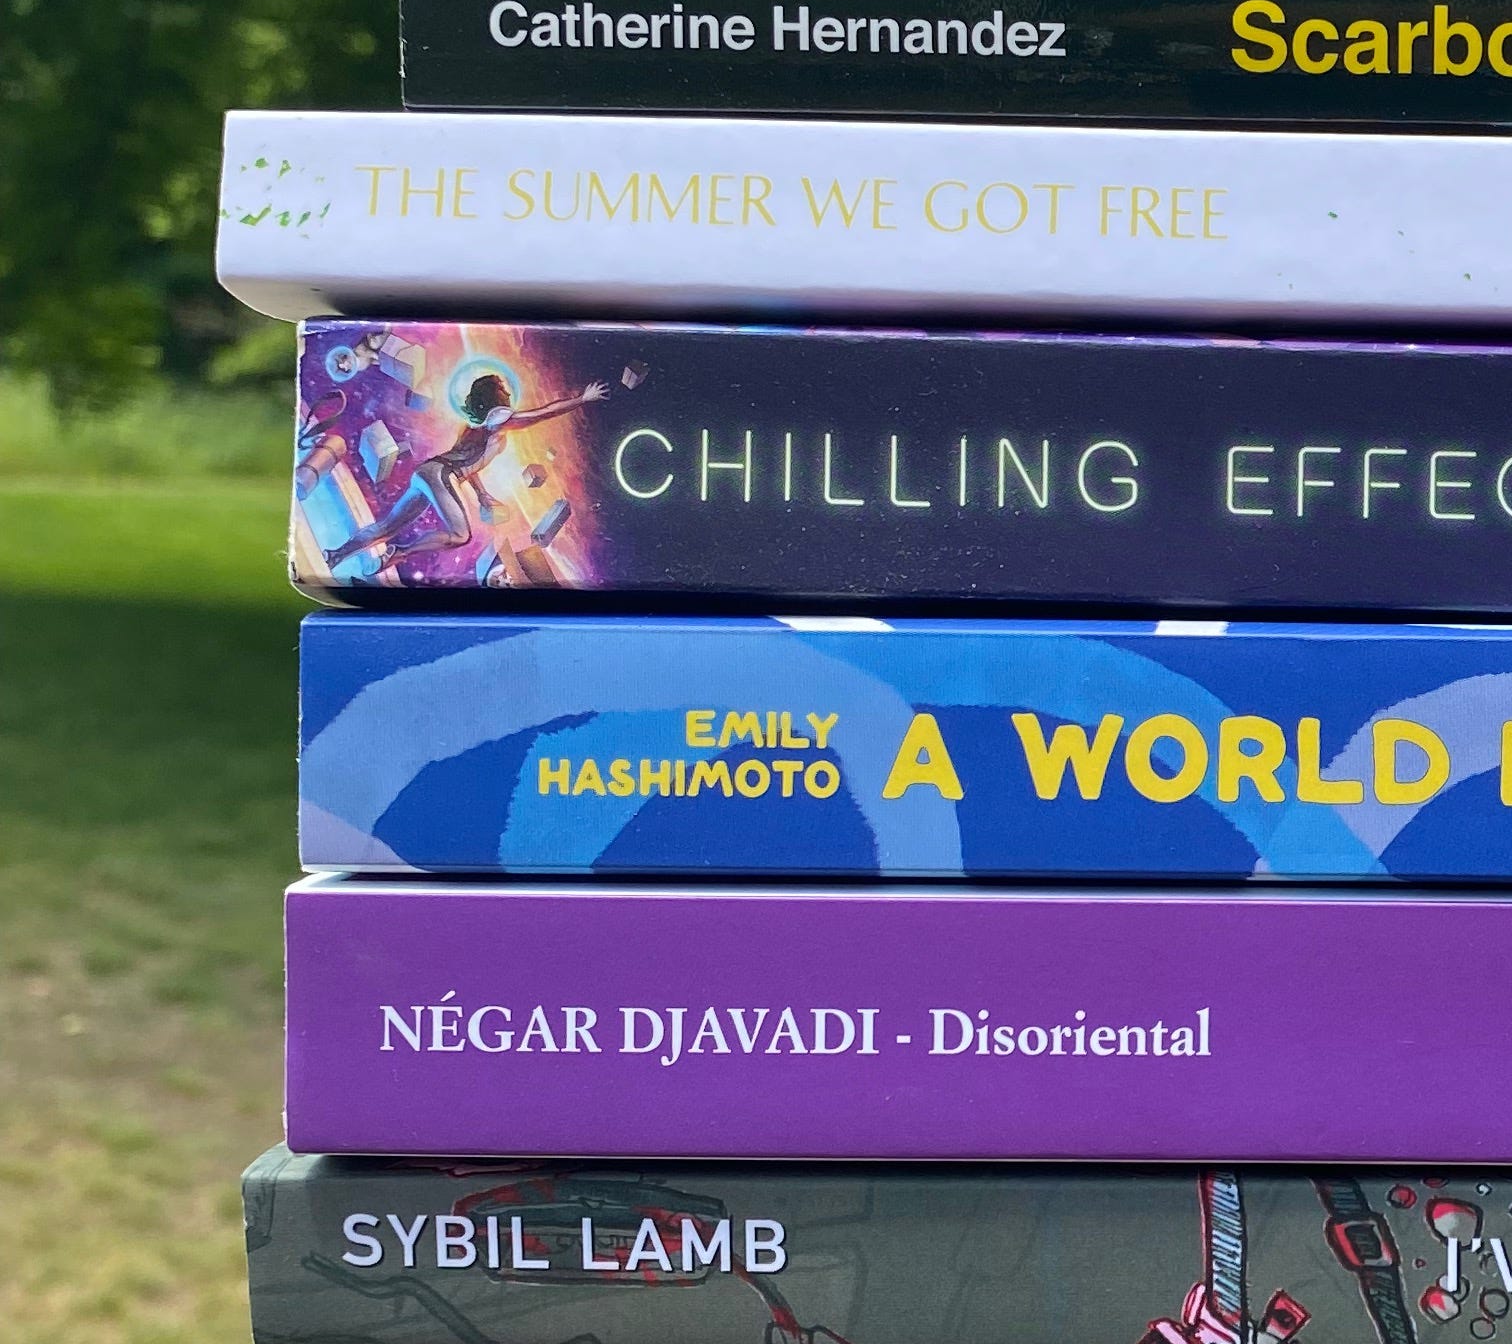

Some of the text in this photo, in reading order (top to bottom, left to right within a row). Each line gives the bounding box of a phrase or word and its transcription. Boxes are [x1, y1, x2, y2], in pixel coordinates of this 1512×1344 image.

[489, 0, 1066, 57] Catherine Hernandez
[354, 165, 1230, 241] THE SUMMER WE GOT FREE
[612, 427, 1142, 515] CHILLING
[685, 709, 840, 750] EMILY
[881, 713, 966, 801] A
[1011, 712, 1451, 806] WORLD
[536, 758, 842, 800] HASHIMOTO
[378, 990, 603, 1056] NÉGAR
[618, 1007, 880, 1066] DJAVADI
[928, 1007, 1213, 1058] Disoriental
[340, 1213, 788, 1276] SYBIL LAMB
